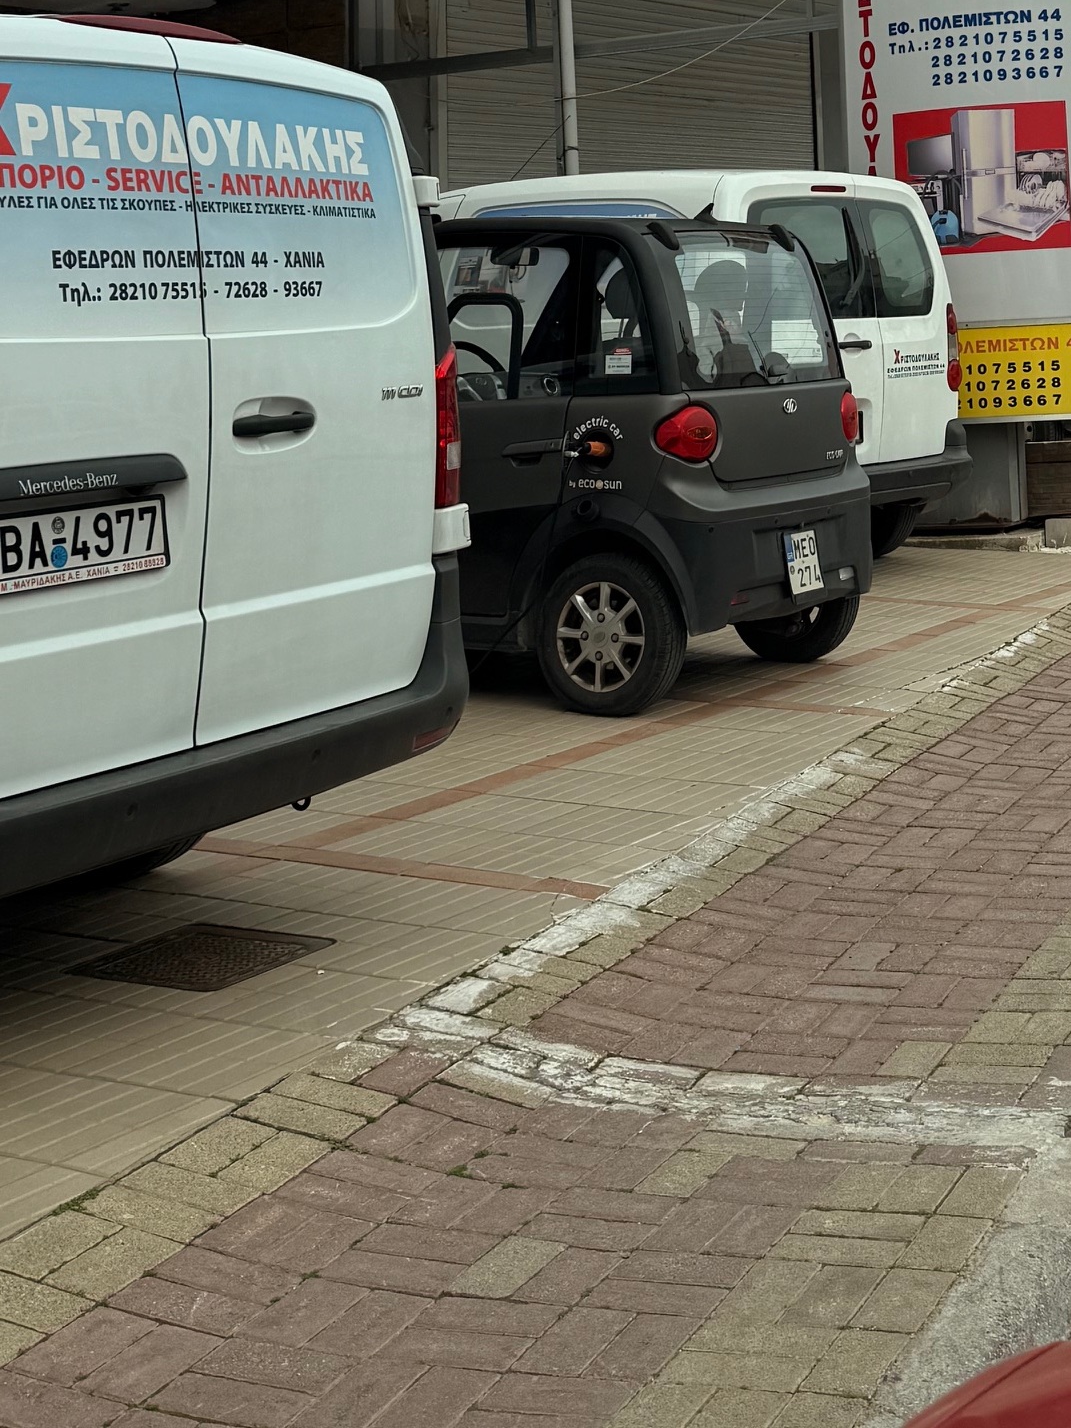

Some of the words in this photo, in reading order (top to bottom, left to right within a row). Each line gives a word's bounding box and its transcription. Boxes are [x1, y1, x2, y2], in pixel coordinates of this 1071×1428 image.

[888, 21, 915, 37] ΕΦ.
[919, 10, 1032, 32] ΠΟΛΕΜΙΣΤΩΝ
[1037, 8, 1062, 22] 44
[931, 47, 1064, 68] 2821072628
[931, 65, 1064, 86] 2821093667
[105, 167, 203, 194] SERVICE
[221, 173, 374, 202] ΑΝΤΑΛΛΑΚΤΙΚΑ
[37, 196, 58, 209] ΓΙΑ
[61, 197, 96, 210] ΟΛΕΣ
[99, 198, 118, 210] ΤΙΣ
[121, 199, 177, 212] ΣΚΟΥΠΕΣ
[255, 203, 306, 216] ΣΥΣΚΕΥΕΣ
[312, 205, 376, 219] ΚΛΙΜΑΤΙΣΤΙΚΑ
[52, 249, 136, 269] ΕΦΕΔΡΩΝ
[142, 249, 245, 269] ΠΟΛΕΜΙΣΤΩΝ
[251, 251, 268, 268] 44
[284, 251, 325, 268] ΧΑΝΙΑ
[224, 282, 268, 299] 72628
[283, 281, 322, 298] 93667
[573, 415, 609, 440] electric
[609, 423, 624, 440] car
[18, 472, 119, 496] Mercedes-Benz
[86, 567, 110, 578] ΧΑΝΙΑ
[797, 564, 821, 588] 274
